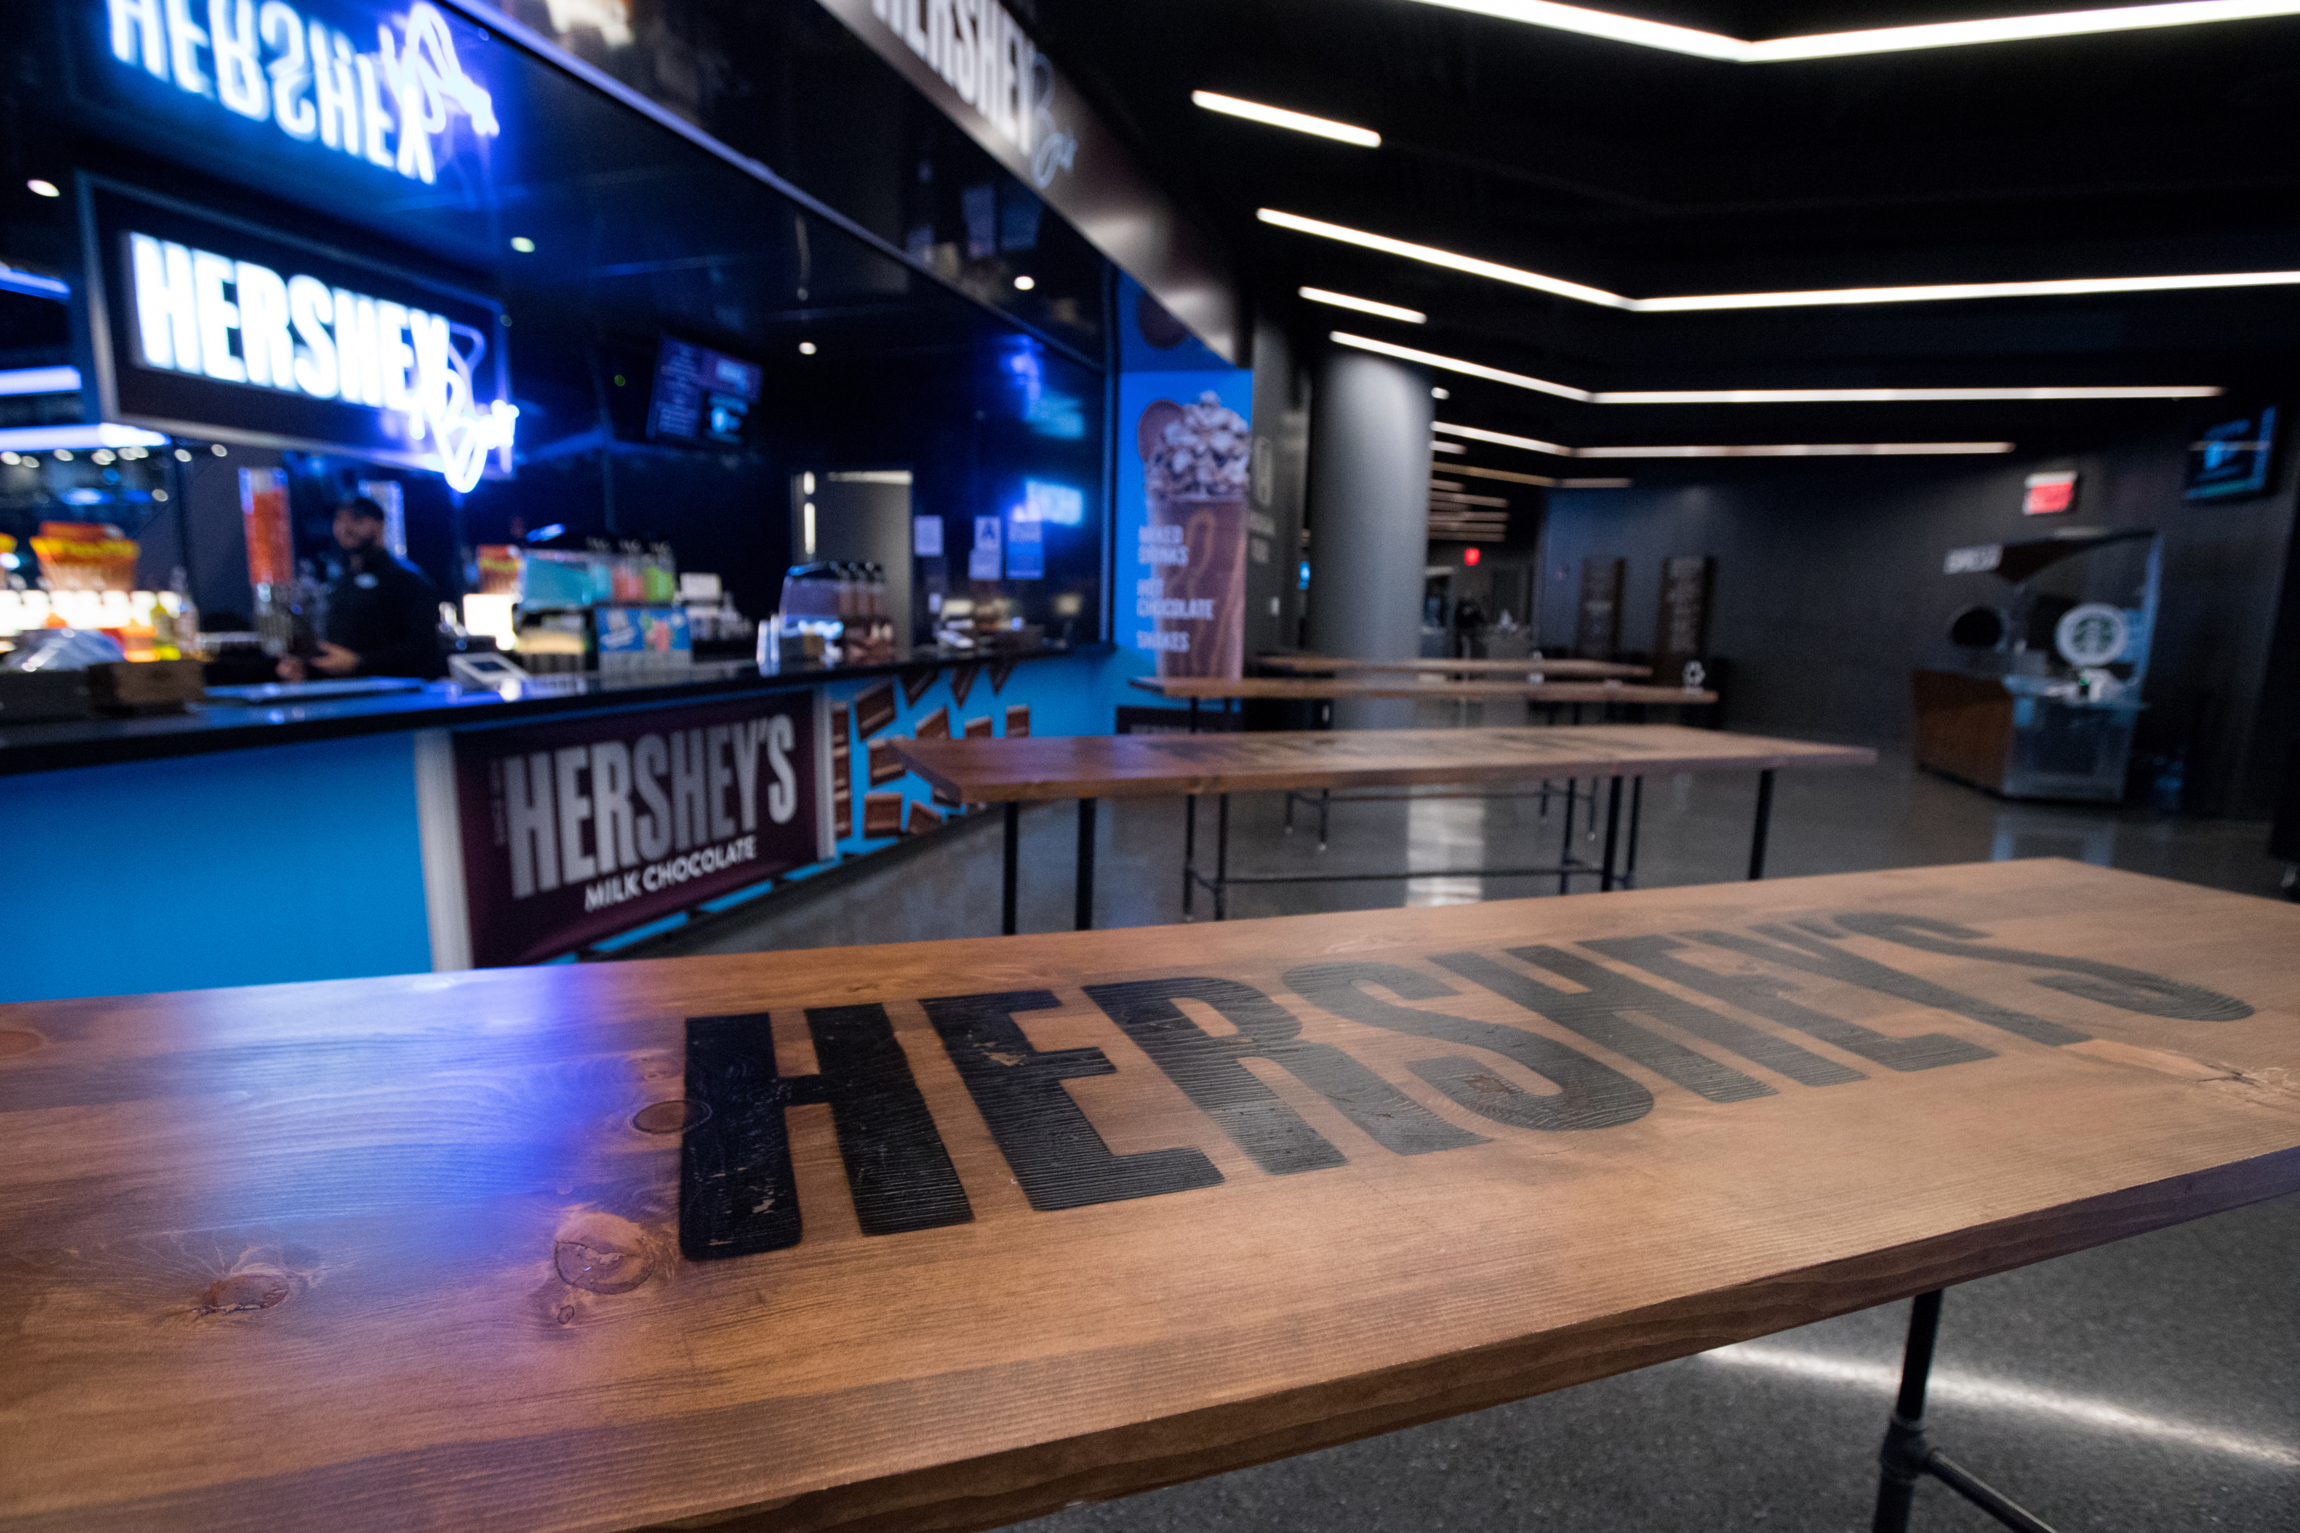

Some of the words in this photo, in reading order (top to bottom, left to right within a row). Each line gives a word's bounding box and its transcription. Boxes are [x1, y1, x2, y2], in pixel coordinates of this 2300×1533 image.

[129, 230, 450, 414] HERSHEY
[1136, 598, 1213, 620] CHOCOLATE
[502, 713, 799, 900] HERSHEY'S
[584, 872, 642, 913] MILK
[642, 834, 759, 892] CHOCOLATE
[678, 911, 2255, 1263] HERSHEY'S
